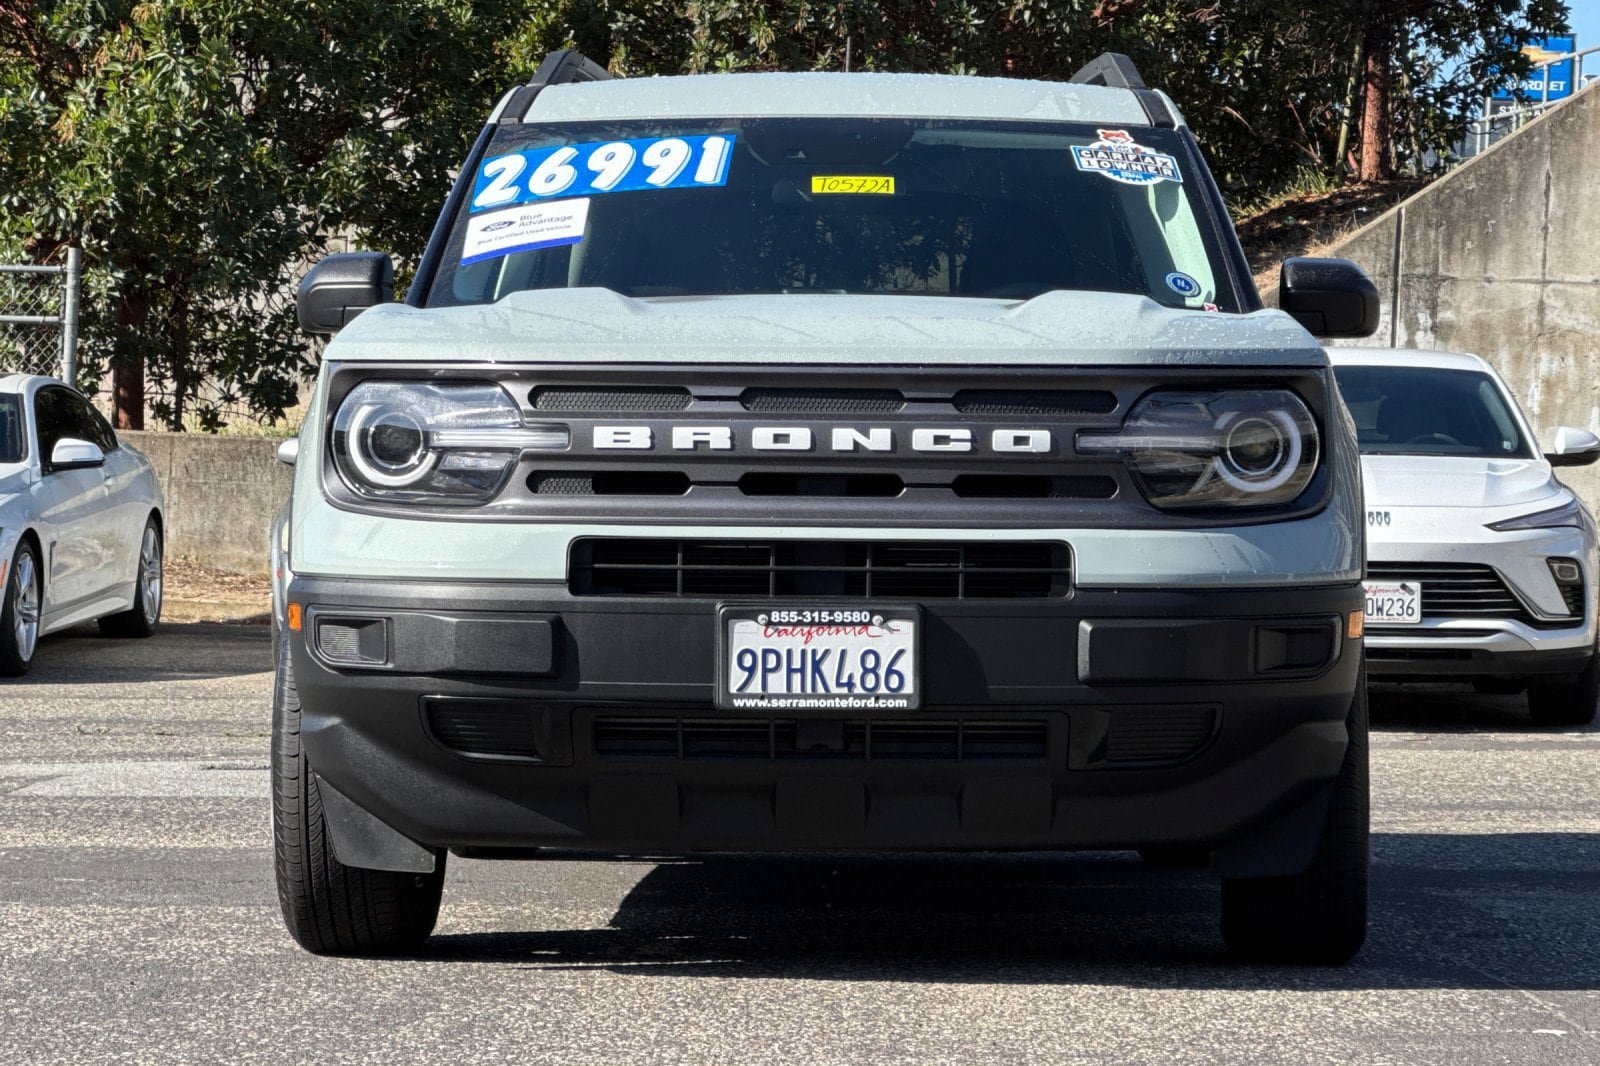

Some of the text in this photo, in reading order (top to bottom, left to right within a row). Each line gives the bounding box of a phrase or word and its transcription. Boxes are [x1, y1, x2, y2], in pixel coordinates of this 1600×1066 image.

[1080, 149, 1170, 168] CARFAX
[1100, 160, 1174, 176] OWNER
[474, 136, 730, 208] 26991
[518, 215, 574, 228] Advantage
[520, 213, 543, 222] Blue
[593, 426, 1051, 453] BRONCO
[1365, 597, 1416, 617] OW236
[770, 611, 871, 623] 855-315-9580
[763, 624, 883, 645] California
[736, 647, 906, 693] 9PHK486
[732, 697, 908, 708] www.serramonteford.com
